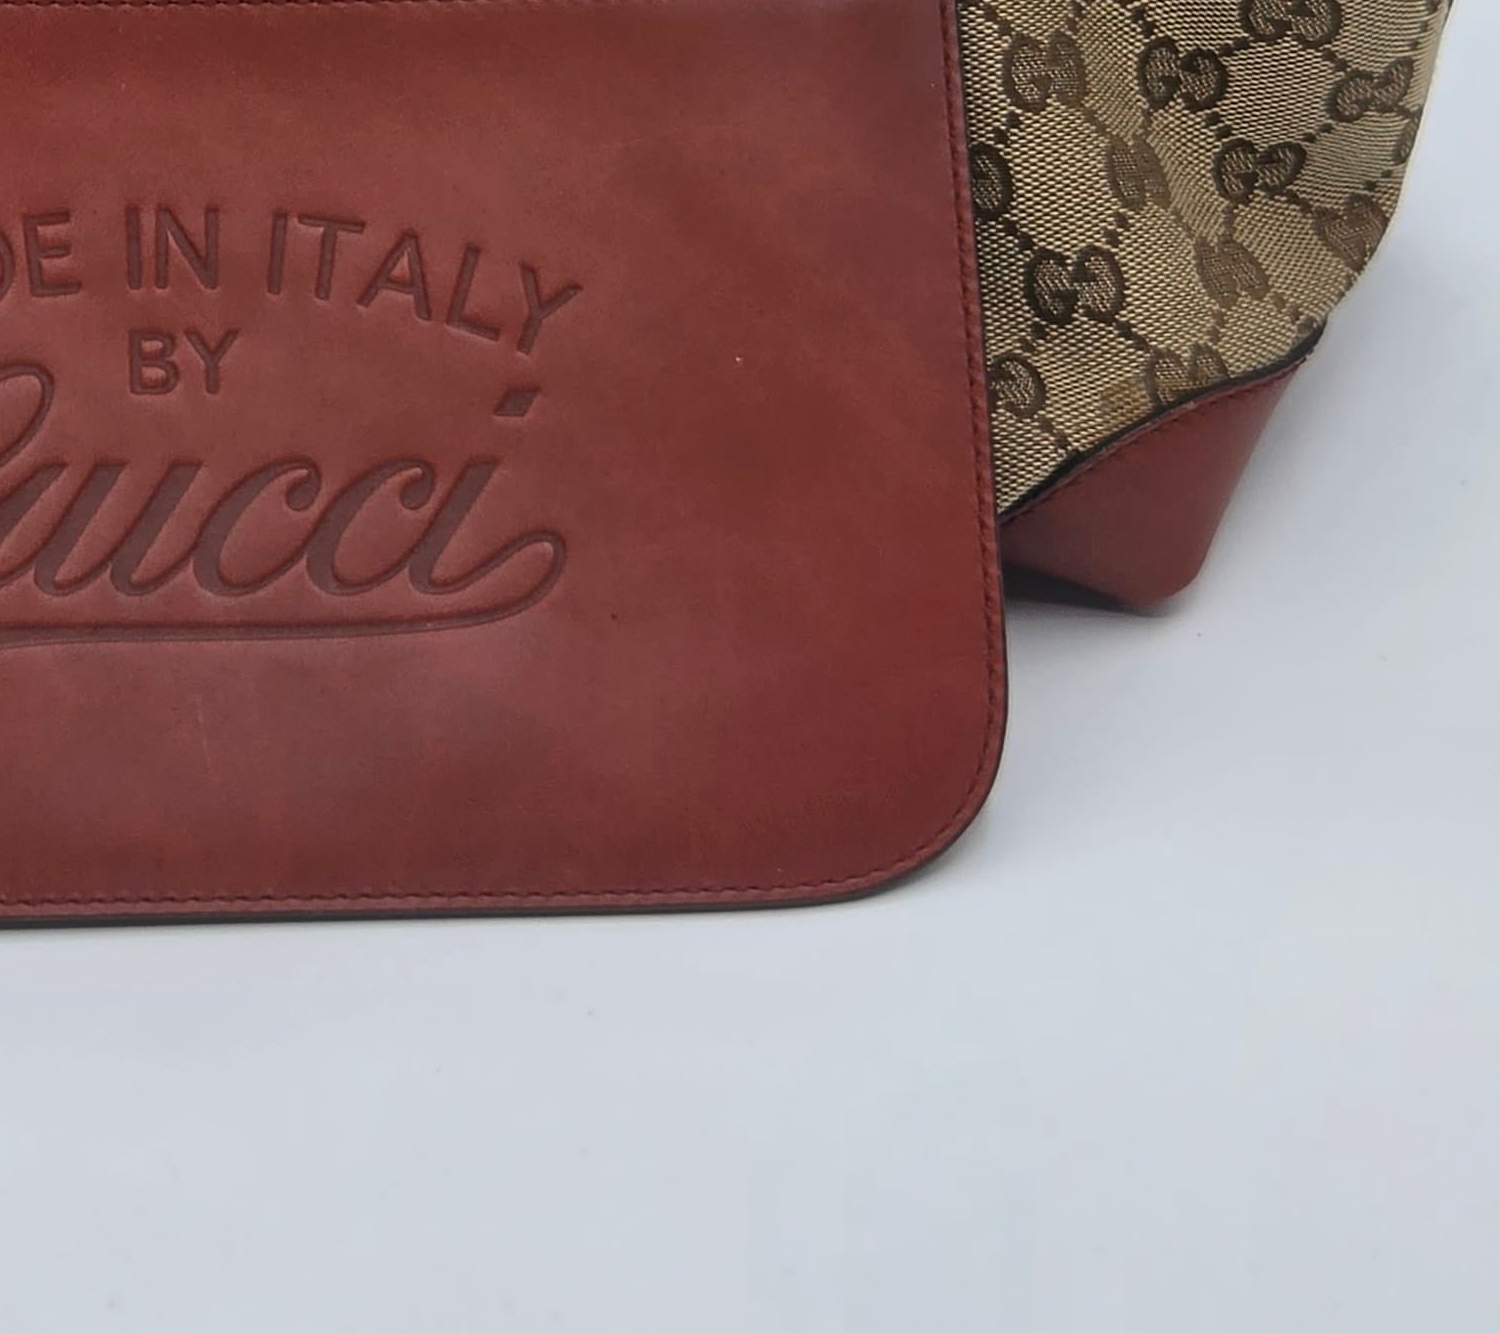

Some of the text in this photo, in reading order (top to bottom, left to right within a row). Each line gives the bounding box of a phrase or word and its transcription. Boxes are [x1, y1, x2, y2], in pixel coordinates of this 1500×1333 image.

[125, 206, 219, 292] IN
[266, 210, 583, 355] ITALY
[129, 328, 241, 396] BY
